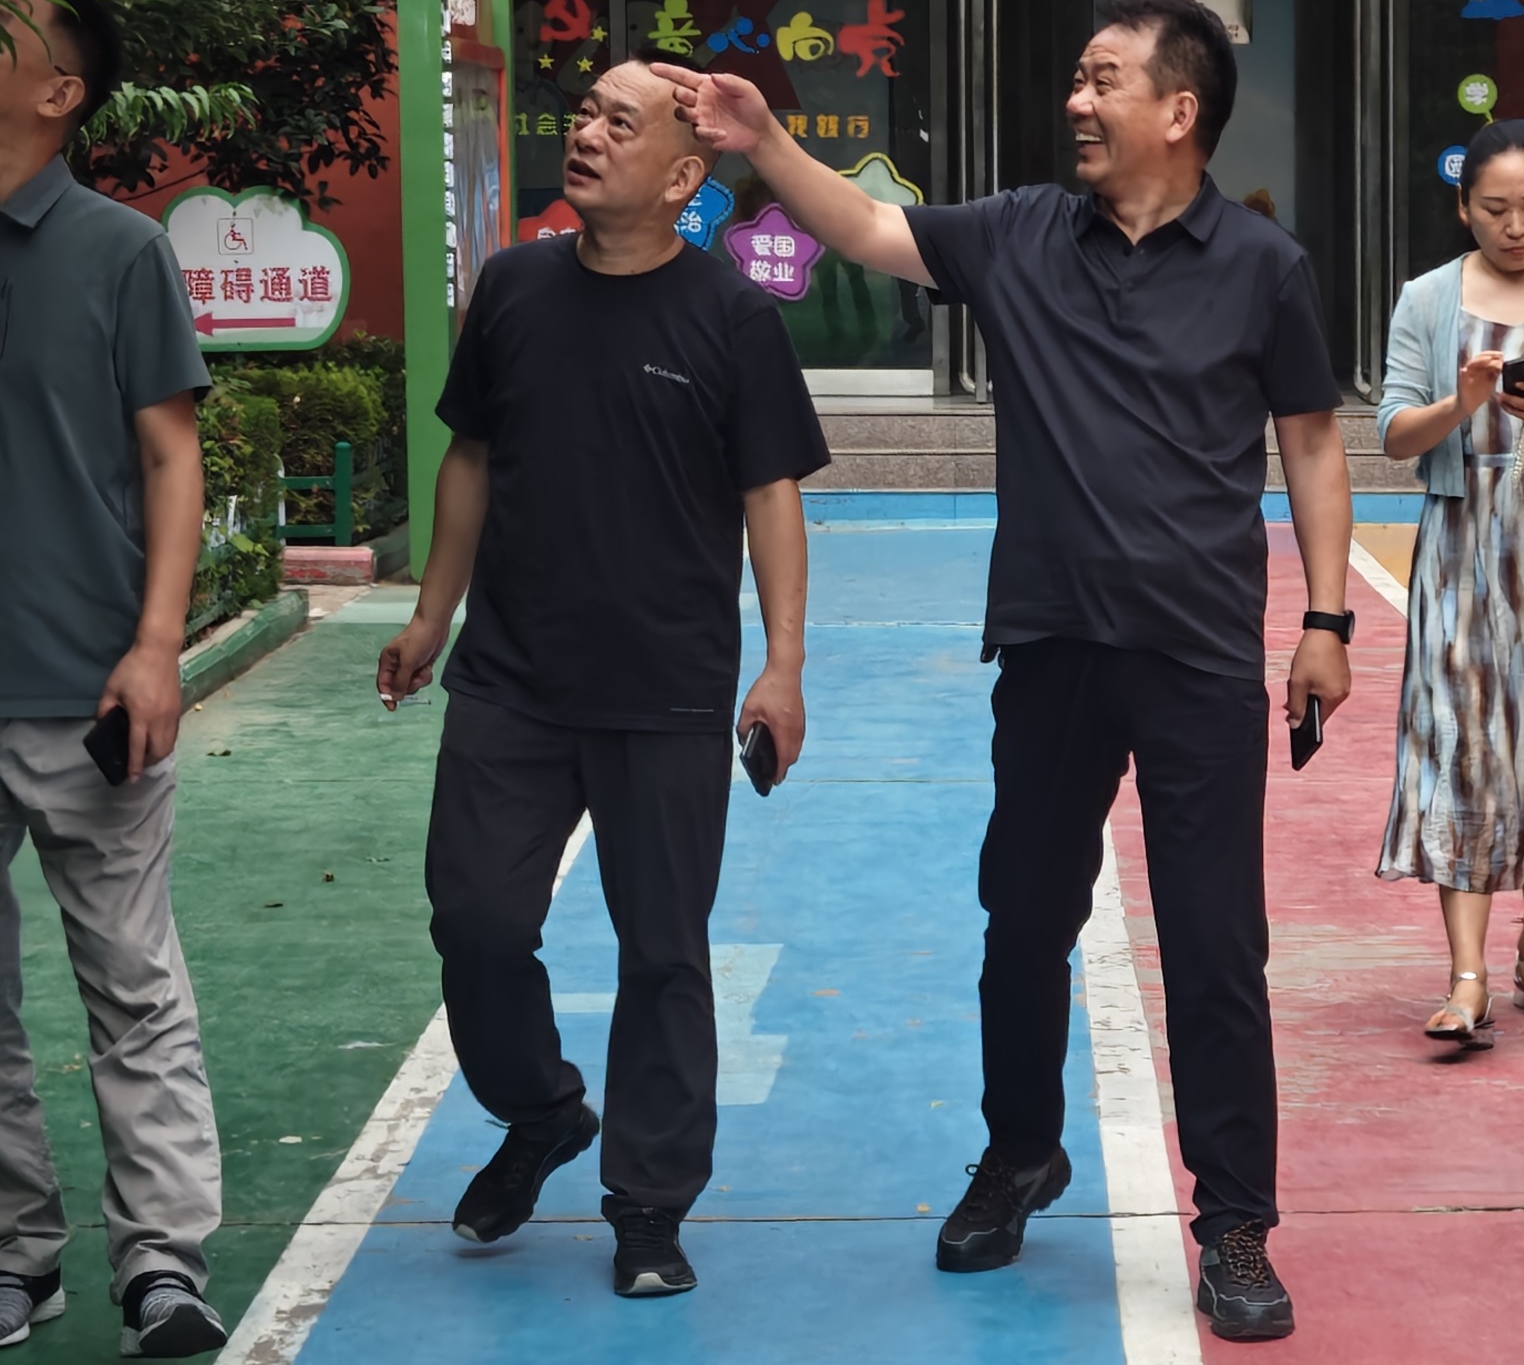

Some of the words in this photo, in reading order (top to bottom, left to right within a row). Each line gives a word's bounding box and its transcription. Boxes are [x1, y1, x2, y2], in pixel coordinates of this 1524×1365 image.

[751, 234, 796, 258] 爱国
[750, 260, 796, 283] 敬业
[181, 265, 333, 305] 障碍通道
